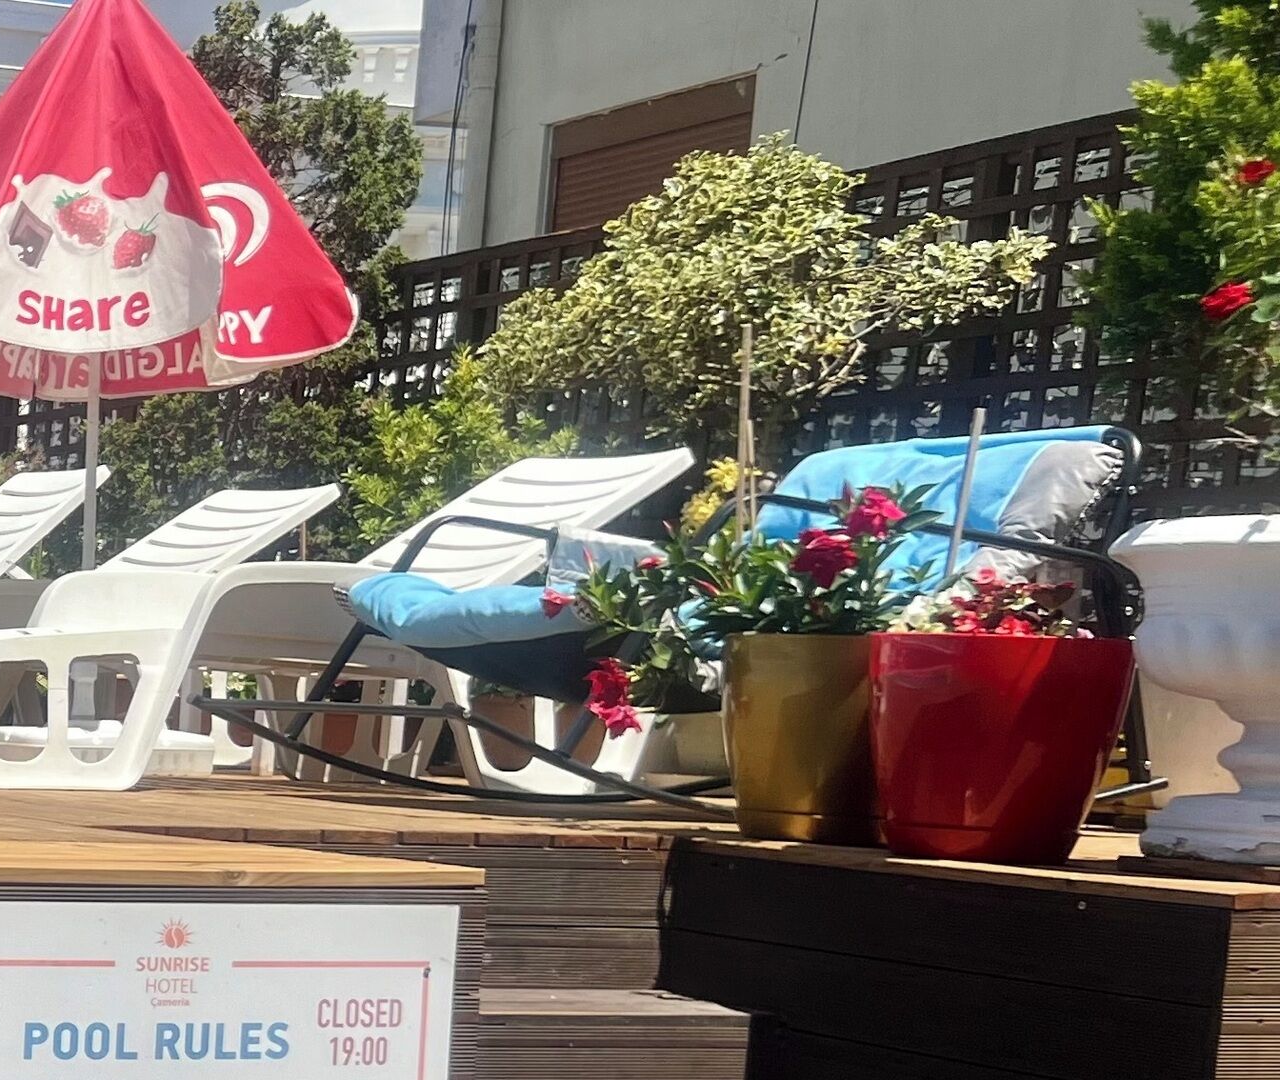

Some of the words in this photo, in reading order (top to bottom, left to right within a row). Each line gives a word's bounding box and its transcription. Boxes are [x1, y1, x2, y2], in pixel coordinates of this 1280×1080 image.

[135, 956, 210, 973] SUNRISE
[145, 977, 199, 994] HOTEL
[317, 998, 403, 1029] CLOSED
[23, 1021, 139, 1061] POOL
[154, 1021, 290, 1061] RULES
[329, 1036, 388, 1066] 19:00
